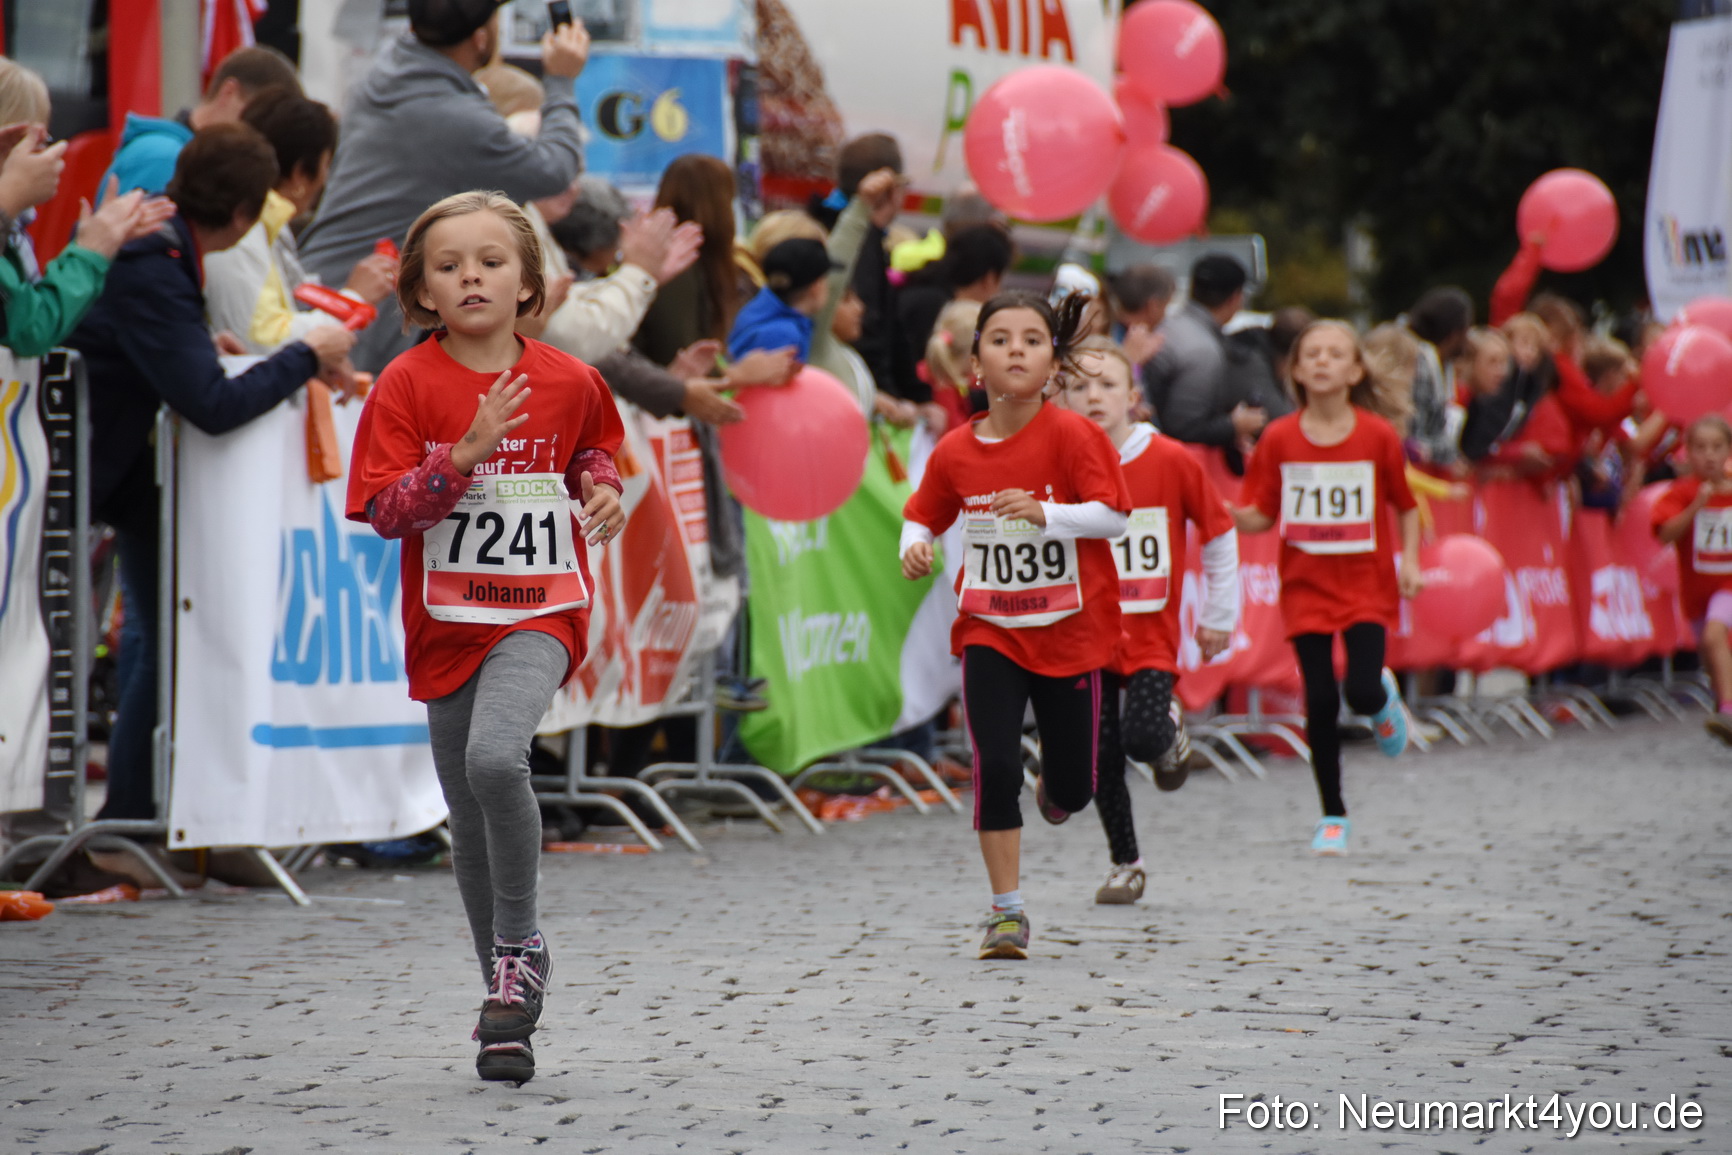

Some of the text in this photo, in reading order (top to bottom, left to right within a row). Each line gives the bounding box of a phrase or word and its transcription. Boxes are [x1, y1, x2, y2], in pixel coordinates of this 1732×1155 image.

[496, 479, 558, 498] BOCK
[1290, 485, 1364, 518] 7191
[446, 511, 558, 566] 7241
[431, 560, 438, 570] 3
[565, 561, 573, 571] K
[972, 539, 1067, 585] 7039
[463, 580, 547, 604] Johanna
[988, 594, 1050, 612] Melissa
